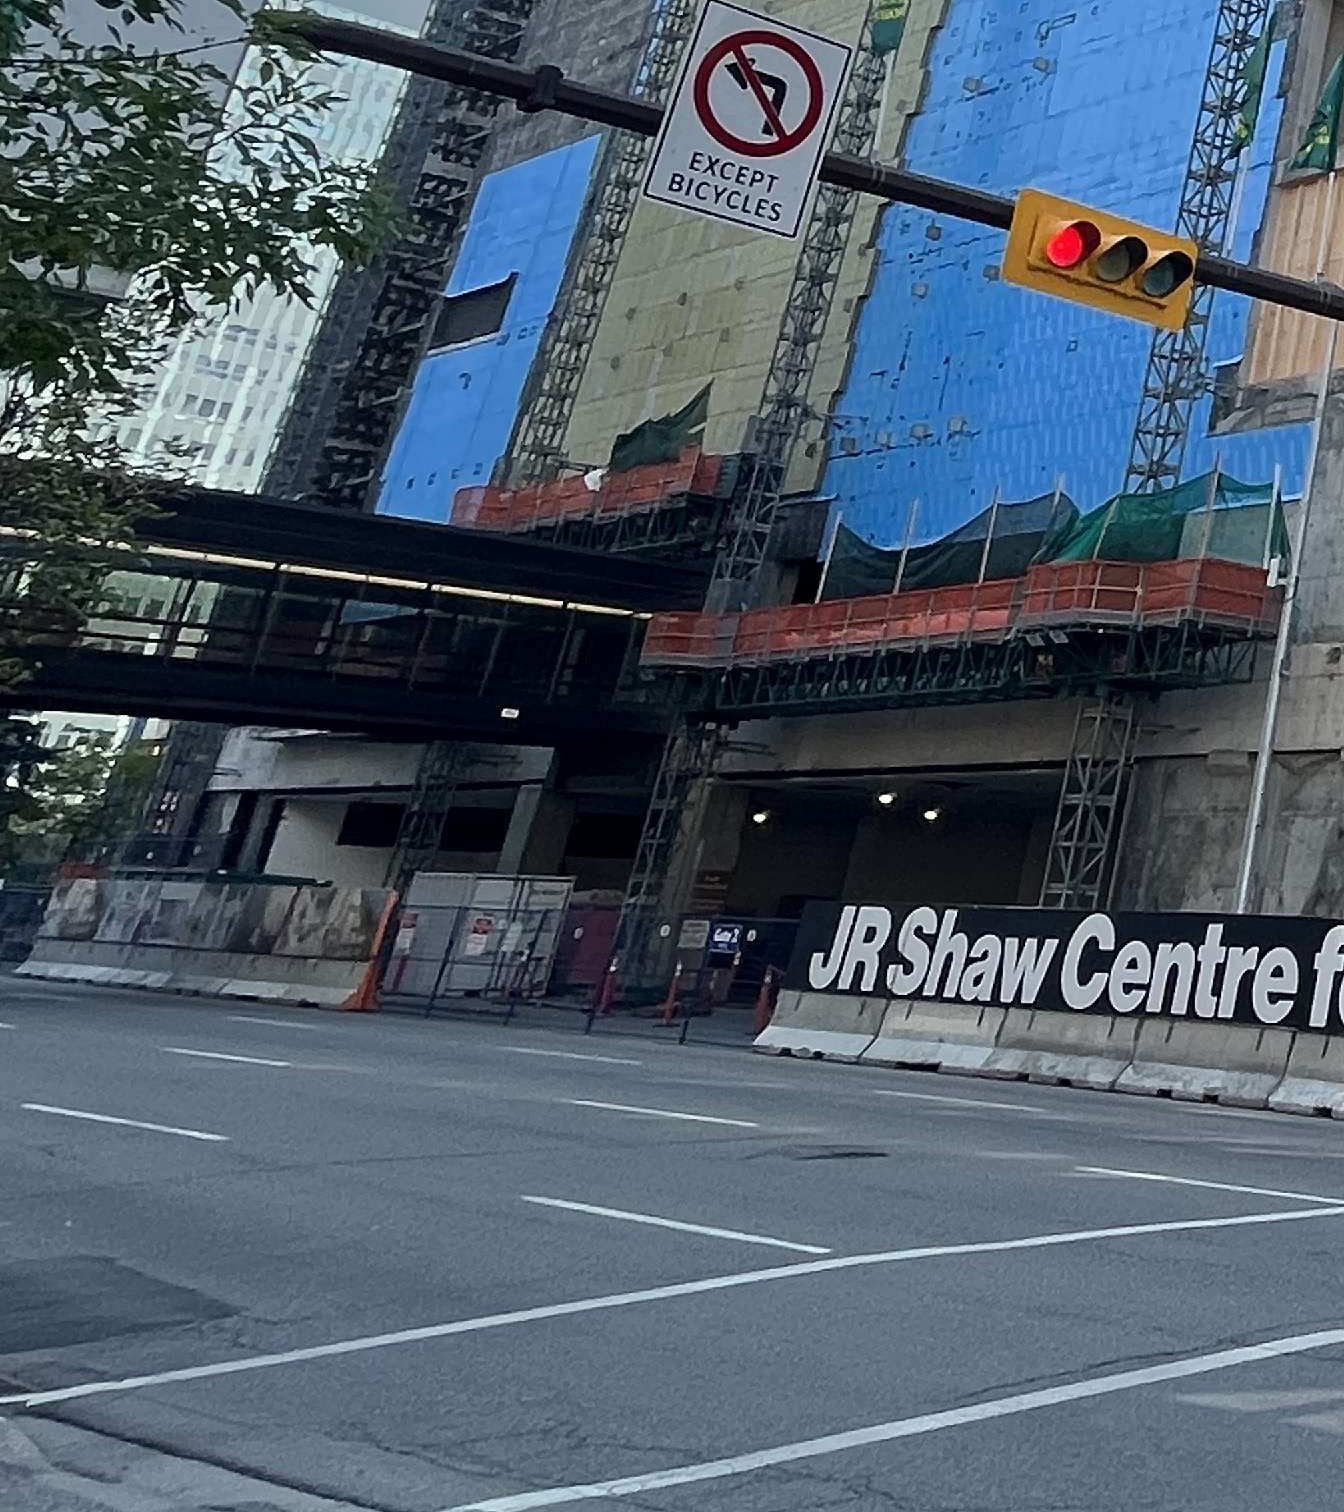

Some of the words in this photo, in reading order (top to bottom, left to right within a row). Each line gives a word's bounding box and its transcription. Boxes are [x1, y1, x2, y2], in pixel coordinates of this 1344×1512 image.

[667, 172, 782, 222] BICYCLES
[688, 151, 780, 194] EXCEPT
[808, 905, 892, 992] JR
[886, 906, 1060, 1004] Shaw
[1060, 912, 1299, 1024] Centre
